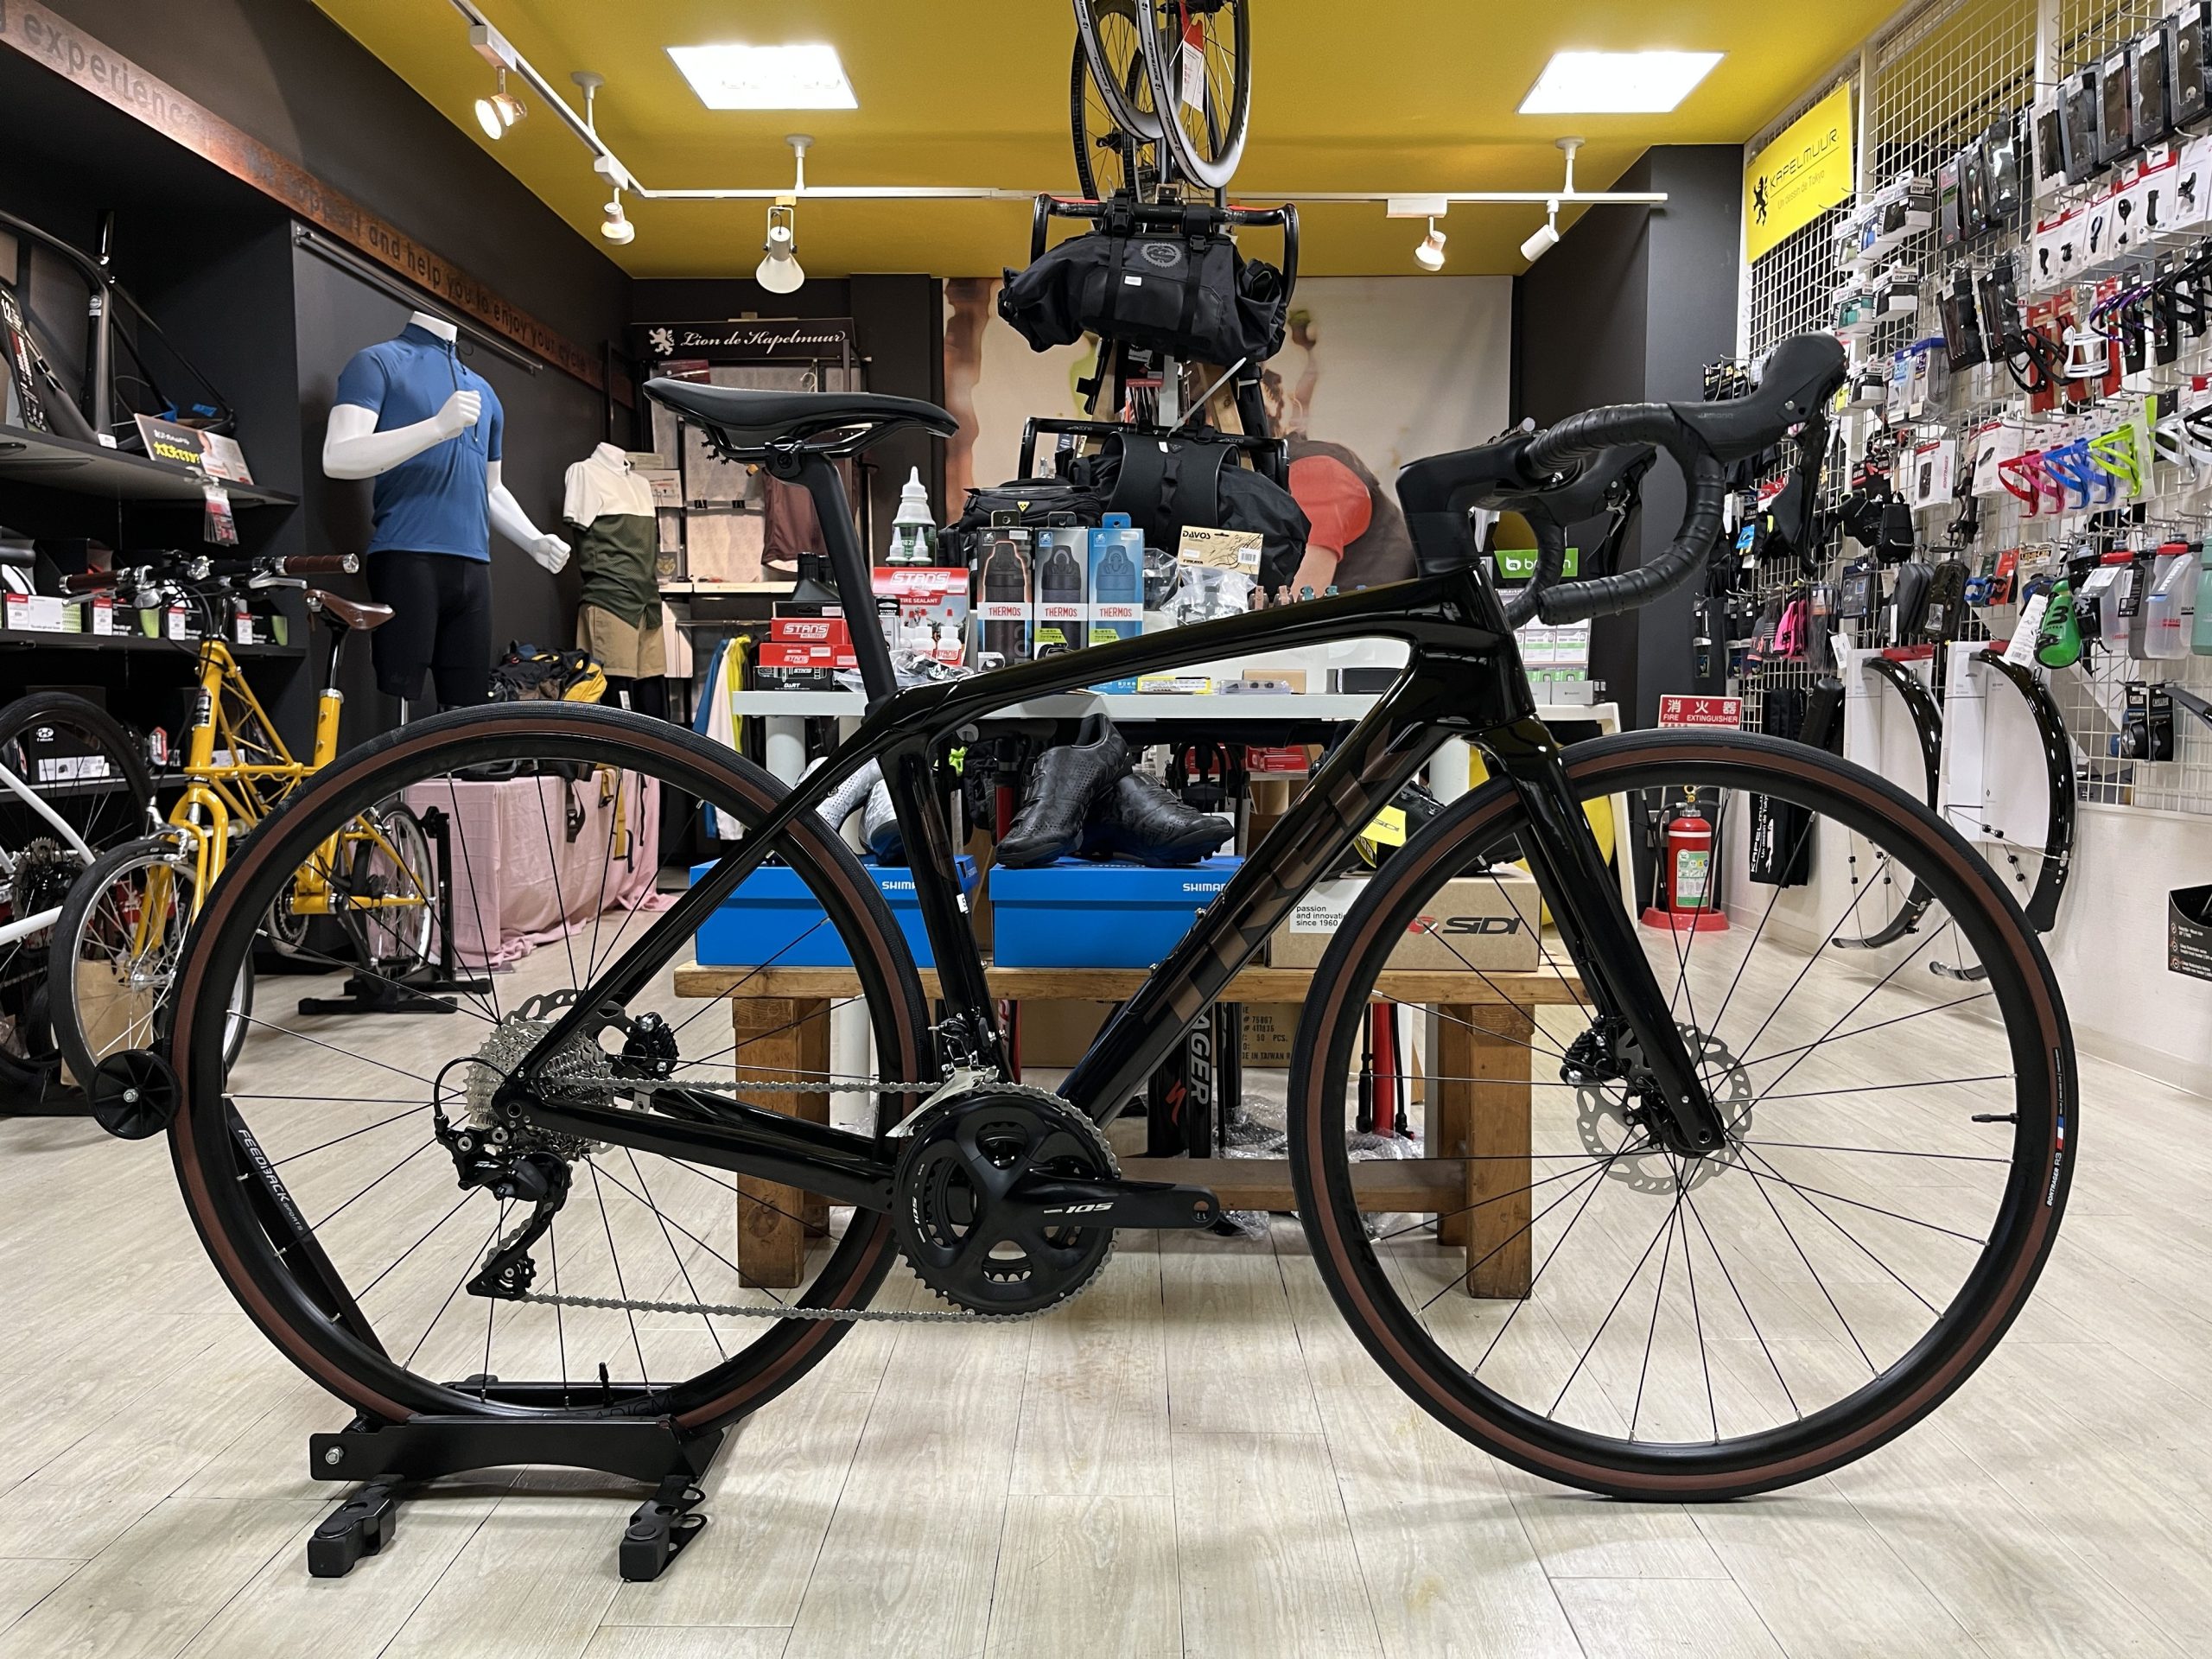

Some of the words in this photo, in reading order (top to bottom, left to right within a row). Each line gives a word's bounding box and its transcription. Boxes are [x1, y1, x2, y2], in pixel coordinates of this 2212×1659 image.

[1770, 129, 1838, 189] KAPELMUUR
[1808, 170, 1825, 188] Tokyo
[369, 223, 400, 262] and
[407, 243, 442, 289] help
[447, 276, 471, 301] you
[493, 305, 528, 340] enjoy
[531, 330, 556, 353] your
[680, 331, 721, 346] Lion
[723, 331, 741, 346] de
[743, 329, 846, 354] Kapelmuur
[988, 607, 1021, 617] THERMOS
[1045, 607, 1077, 617] THERMOS
[1099, 607, 1133, 618] THERMOS
[784, 624, 829, 633] STANS
[1667, 699, 1737, 715] 消火器
[238, 1128, 290, 1203] FEEDBACK
[283, 1202, 303, 1231] SPORTS
[2046, 1167, 2060, 1207] BONTRAGER
[2054, 1152, 2063, 1166] R3
[1065, 1202, 1115, 1214] 105
